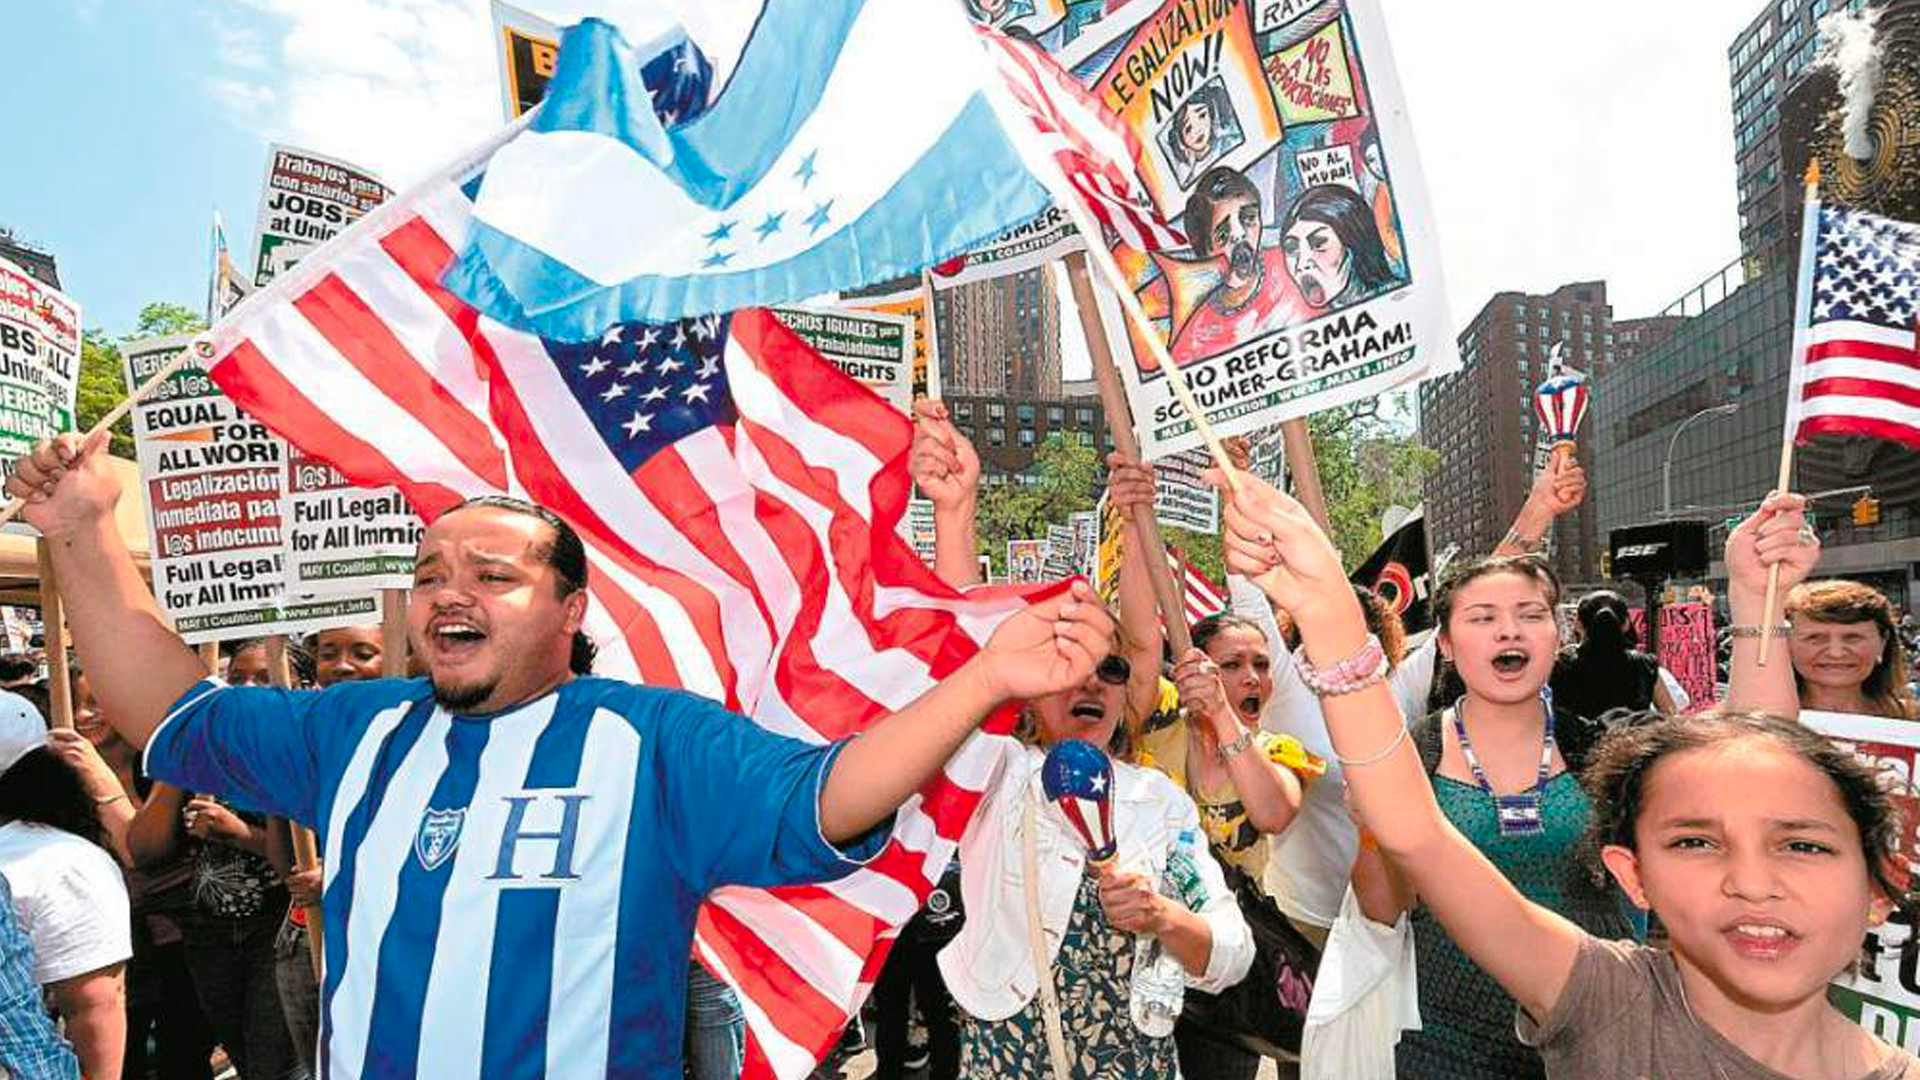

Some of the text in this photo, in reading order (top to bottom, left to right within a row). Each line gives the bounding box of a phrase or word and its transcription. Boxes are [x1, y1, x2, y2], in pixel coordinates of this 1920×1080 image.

[1263, 0, 1304, 27] RA
[1111, 0, 1238, 105] EGALIZATION
[1304, 38, 1331, 63] NO
[1150, 29, 1224, 123] NOW!
[278, 153, 348, 185] Trabajos
[1300, 151, 1345, 172] NO AL
[273, 174, 299, 190] con
[302, 180, 358, 206] salarios
[268, 192, 342, 224] JOBS
[270, 216, 290, 233] at
[996, 228, 1064, 257] COALITION
[775, 312, 824, 332] ECHOS
[826, 316, 877, 338] IGUALES
[1225, 310, 1377, 378] REFORMA
[145, 403, 227, 431] EQUAL
[1205, 398, 1266, 424] OALITION
[212, 424, 268, 442] FOR
[158, 449, 199, 473] ALL
[294, 492, 416, 523] Full Legali
[291, 530, 318, 551] for
[323, 526, 349, 549] All
[166, 554, 285, 584] Full Legal
[302, 563, 324, 577] MAY
[332, 559, 377, 576] Coalition
[165, 589, 193, 609] for
[198, 584, 224, 606] All
[211, 611, 264, 627] Coalition
[486, 796, 593, 880] H
